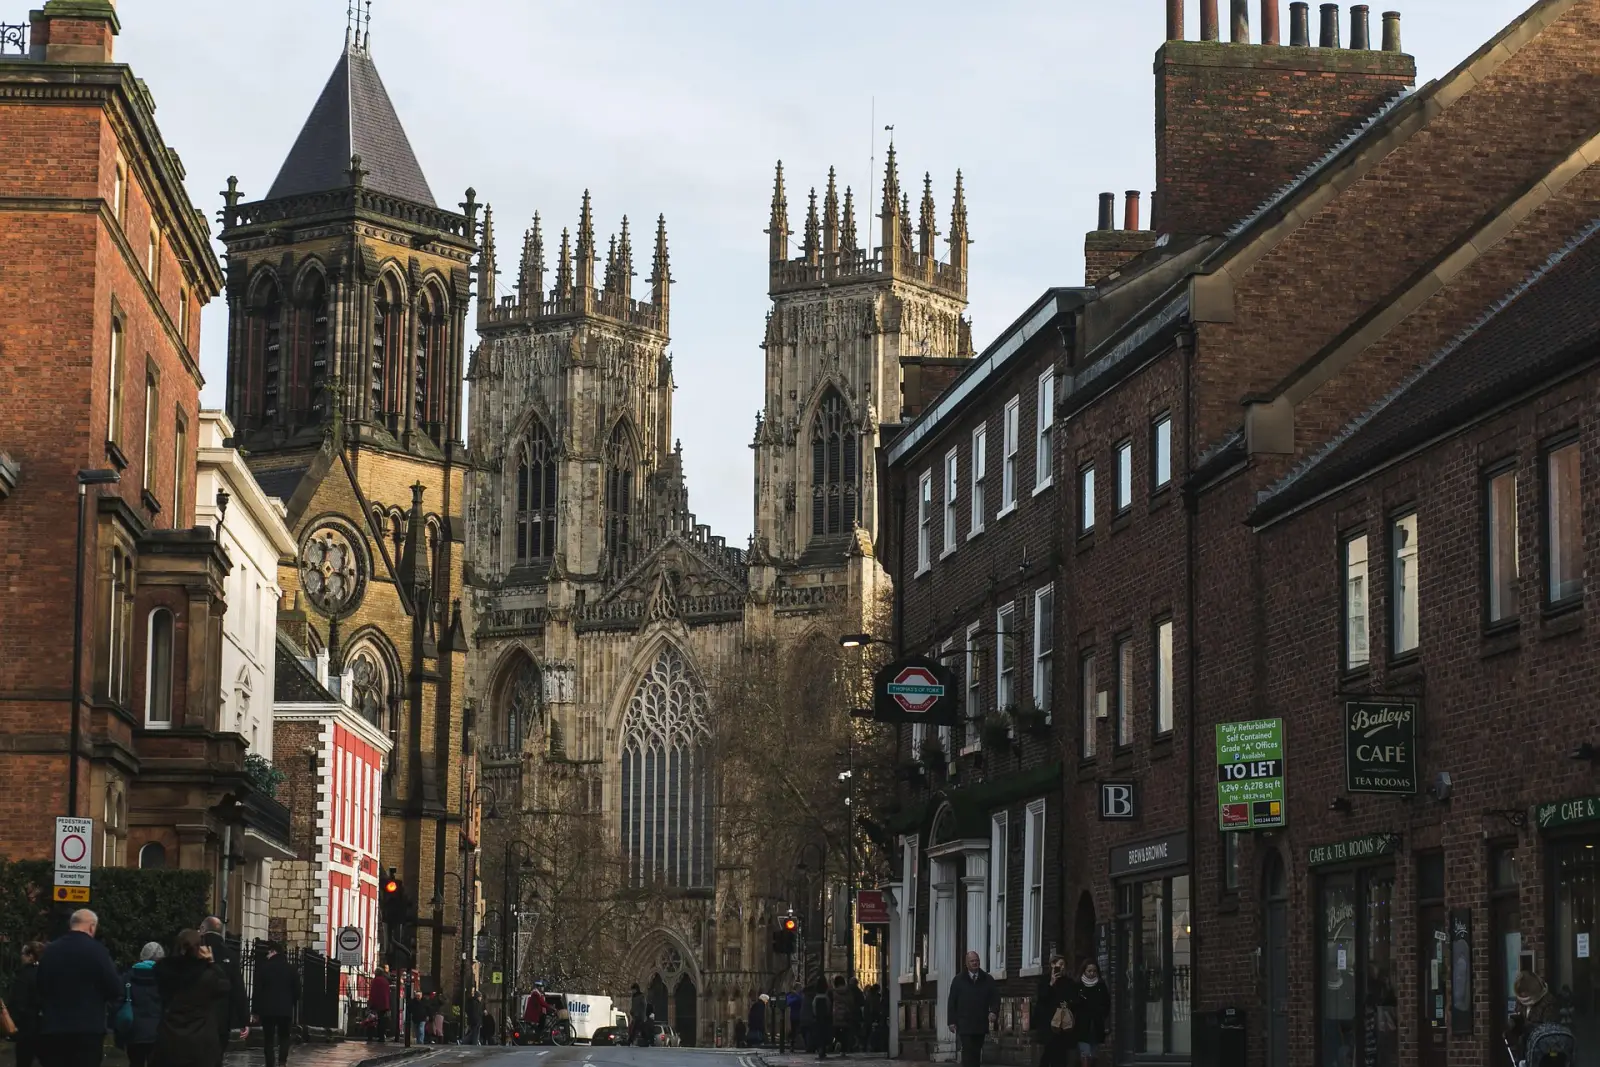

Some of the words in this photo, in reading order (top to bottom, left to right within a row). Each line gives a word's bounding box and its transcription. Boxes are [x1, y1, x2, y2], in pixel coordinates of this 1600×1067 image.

[1351, 708, 1411, 731] Baileys
[1221, 725, 1237, 734] Fully
[1238, 720, 1276, 732] Refurbished
[1226, 733, 1239, 743] Self
[1240, 731, 1272, 742] Contained
[1221, 744, 1241, 753] Grade
[1255, 741, 1278, 750] Offices
[1356, 741, 1406, 763] CAFÉ
[1242, 751, 1266, 760] Available
[1224, 763, 1247, 780] TO
[1250, 760, 1276, 778] LET
[1221, 784, 1239, 794] 1,249
[1244, 782, 1264, 792] 6,278
[1274, 780, 1281, 788] ft
[1354, 777, 1372, 786] TEA
[1374, 777, 1411, 787] ROOMS
[1104, 786, 1131, 815] B
[1561, 800, 1584, 821] CAFE
[1587, 799, 1595, 816] &
[62, 825, 86, 834] ZONE
[1309, 847, 1325, 863] CAFE
[1326, 846, 1333, 860] &
[1334, 843, 1347, 858] TEA
[1349, 838, 1374, 857] ROOMS
